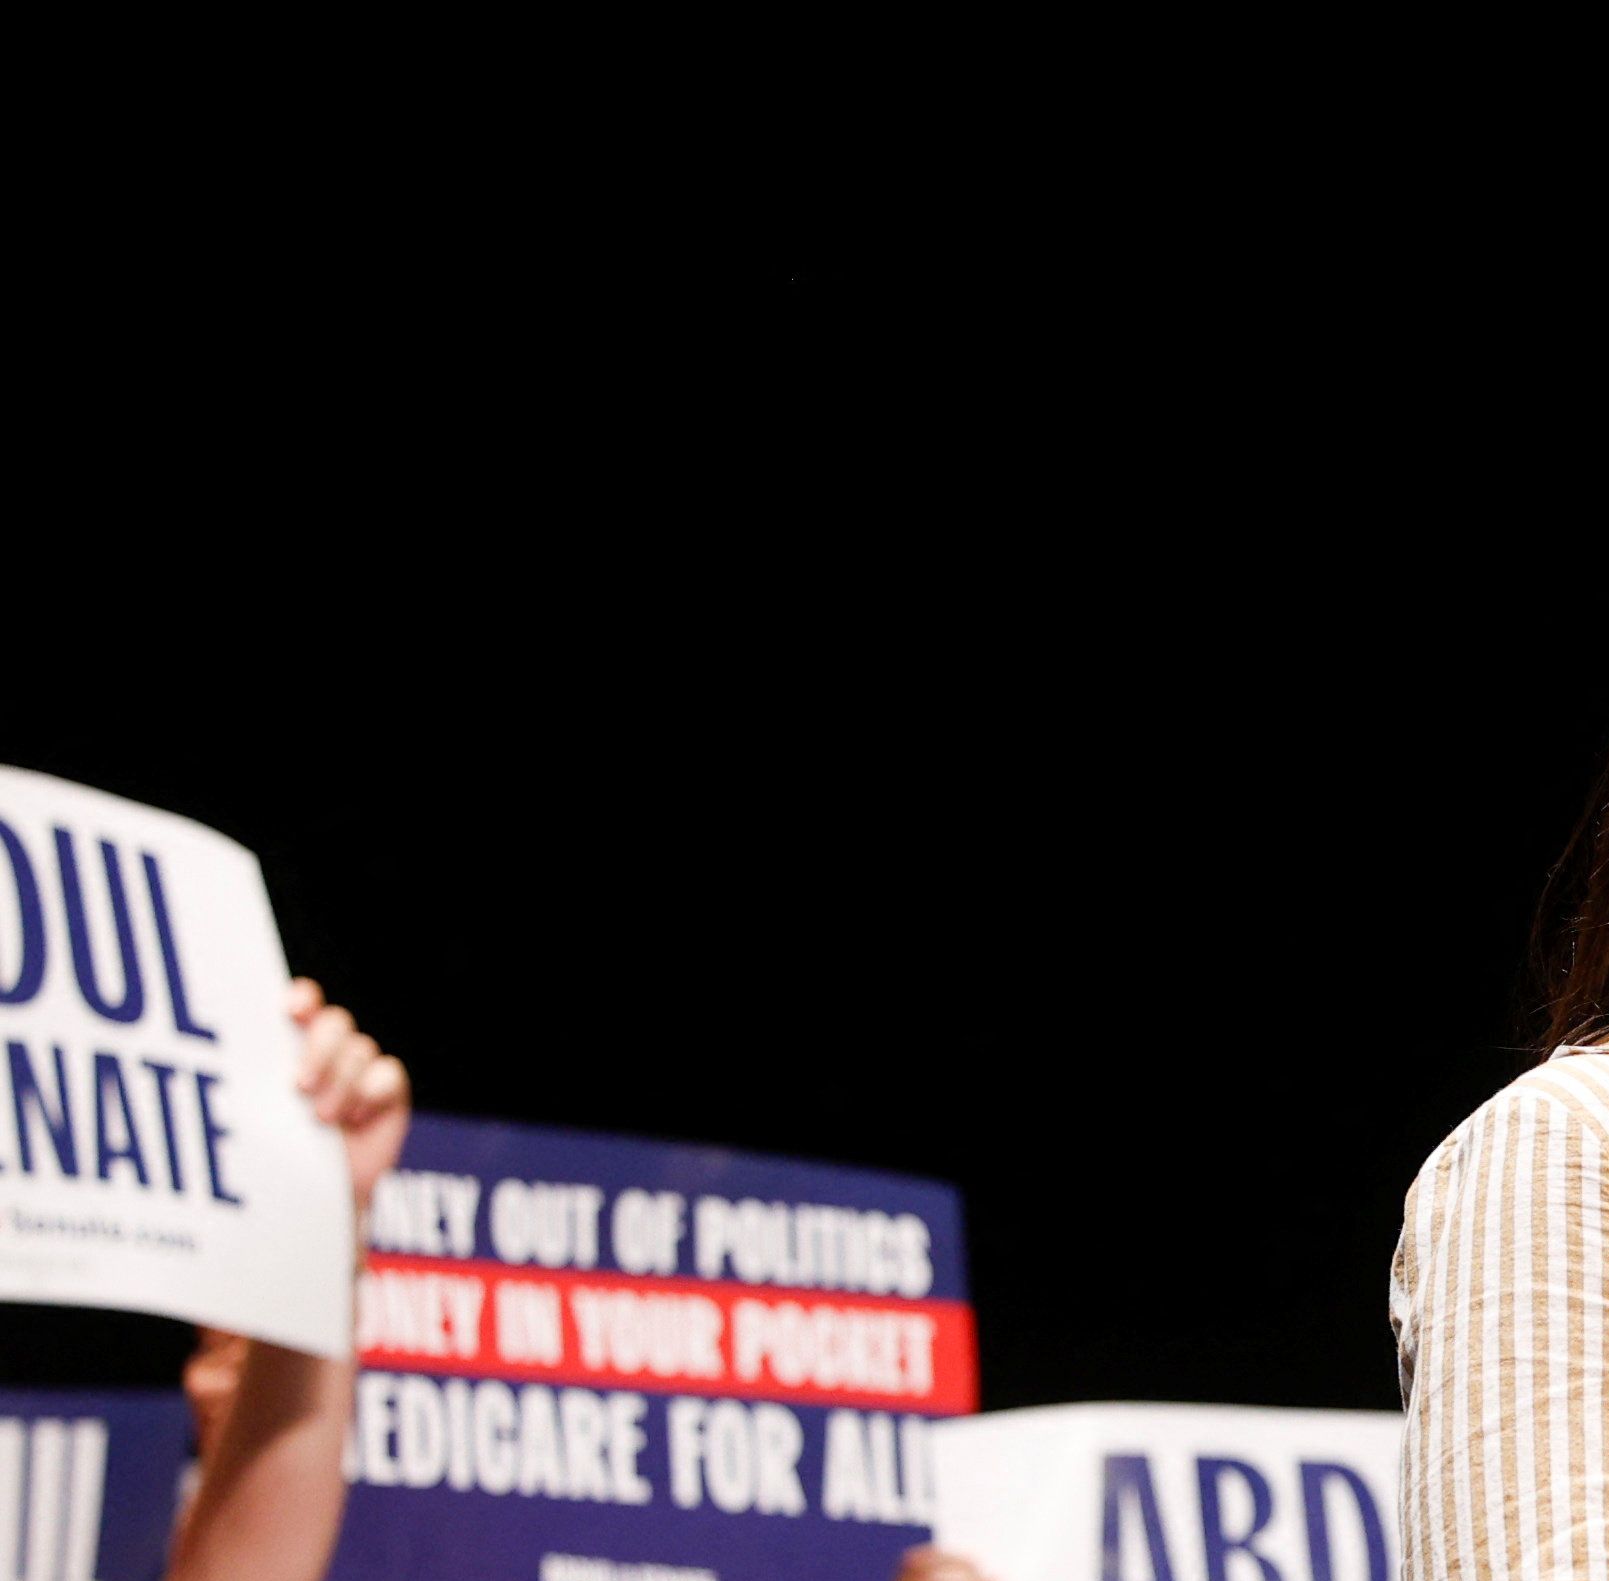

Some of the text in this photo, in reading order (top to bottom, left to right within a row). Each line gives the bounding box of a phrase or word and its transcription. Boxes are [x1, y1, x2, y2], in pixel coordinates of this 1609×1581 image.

[490, 1177, 605, 1272] OUT
[611, 1188, 686, 1277] OF
[693, 1194, 934, 1300] POLITICS
[494, 1277, 564, 1370] IN
[570, 1284, 726, 1382] YOUR
[732, 1297, 937, 1398] POCKET
[667, 1395, 807, 1516] FOR
